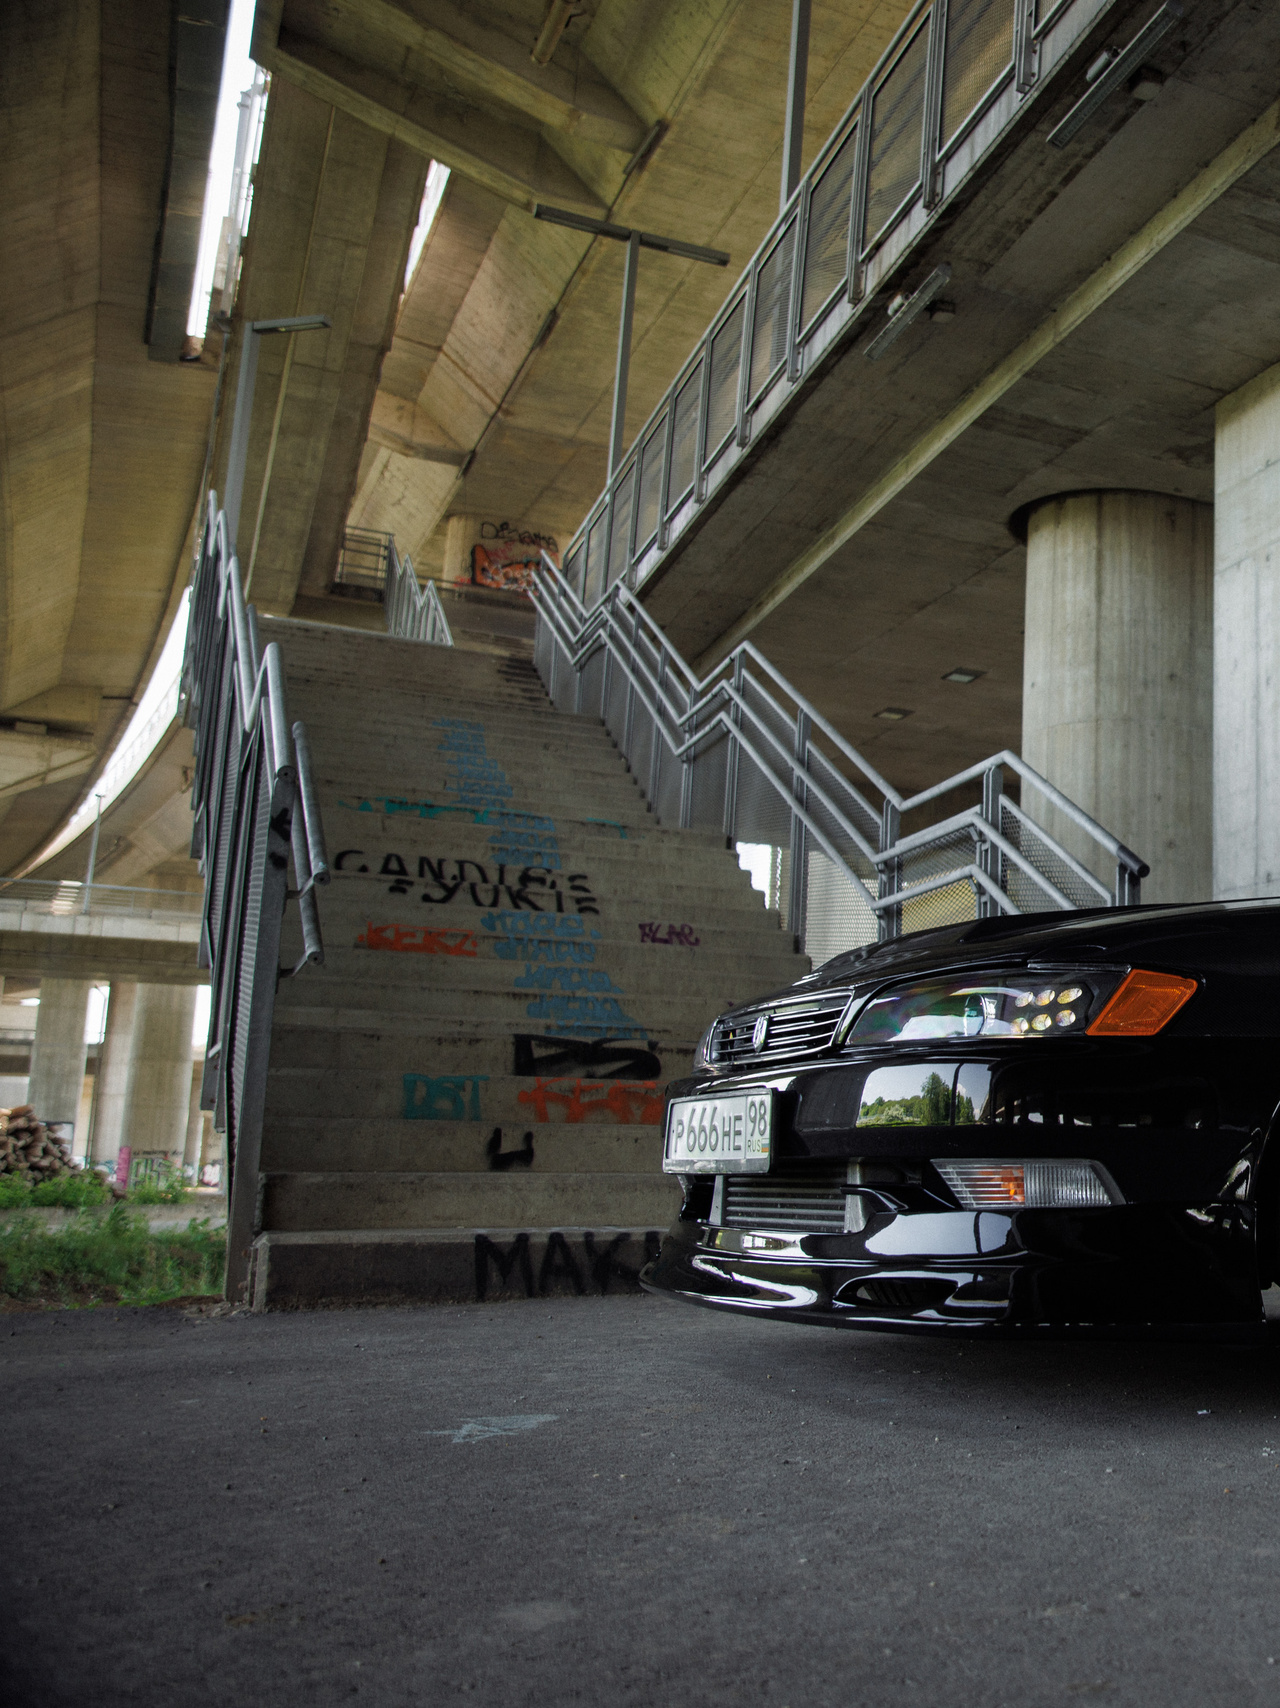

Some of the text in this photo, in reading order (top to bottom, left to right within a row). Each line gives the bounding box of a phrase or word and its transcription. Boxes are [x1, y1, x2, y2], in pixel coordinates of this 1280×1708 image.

[674, 1100, 767, 1153] P666HE 98
[747, 1139, 761, 1153] RUS
